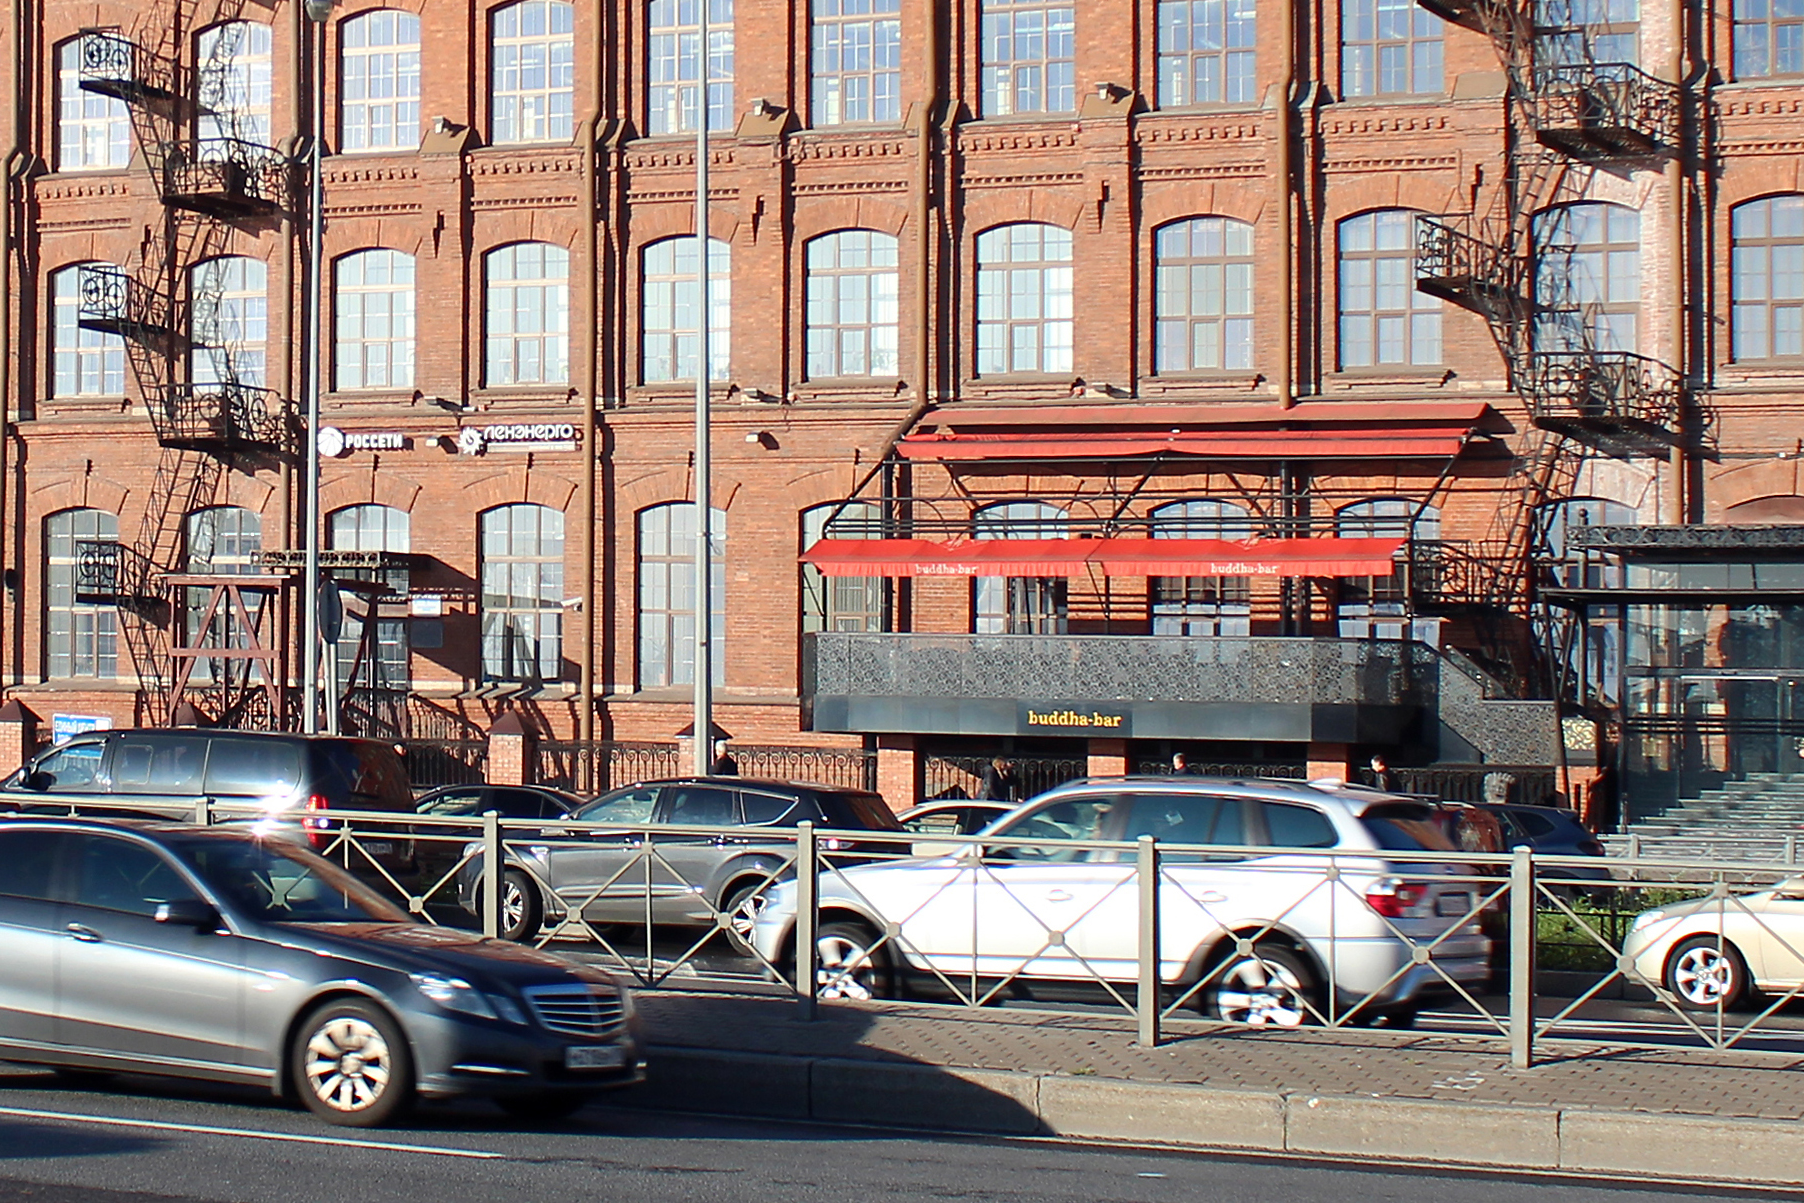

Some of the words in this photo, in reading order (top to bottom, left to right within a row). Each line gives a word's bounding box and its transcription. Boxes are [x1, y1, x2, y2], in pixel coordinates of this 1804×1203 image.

[345, 434, 403, 448] РОССЕТИ
[915, 563, 979, 574] buddha-bar
[1210, 562, 1280, 574] buddha-bar
[1028, 710, 1122, 727] buddha-bar
